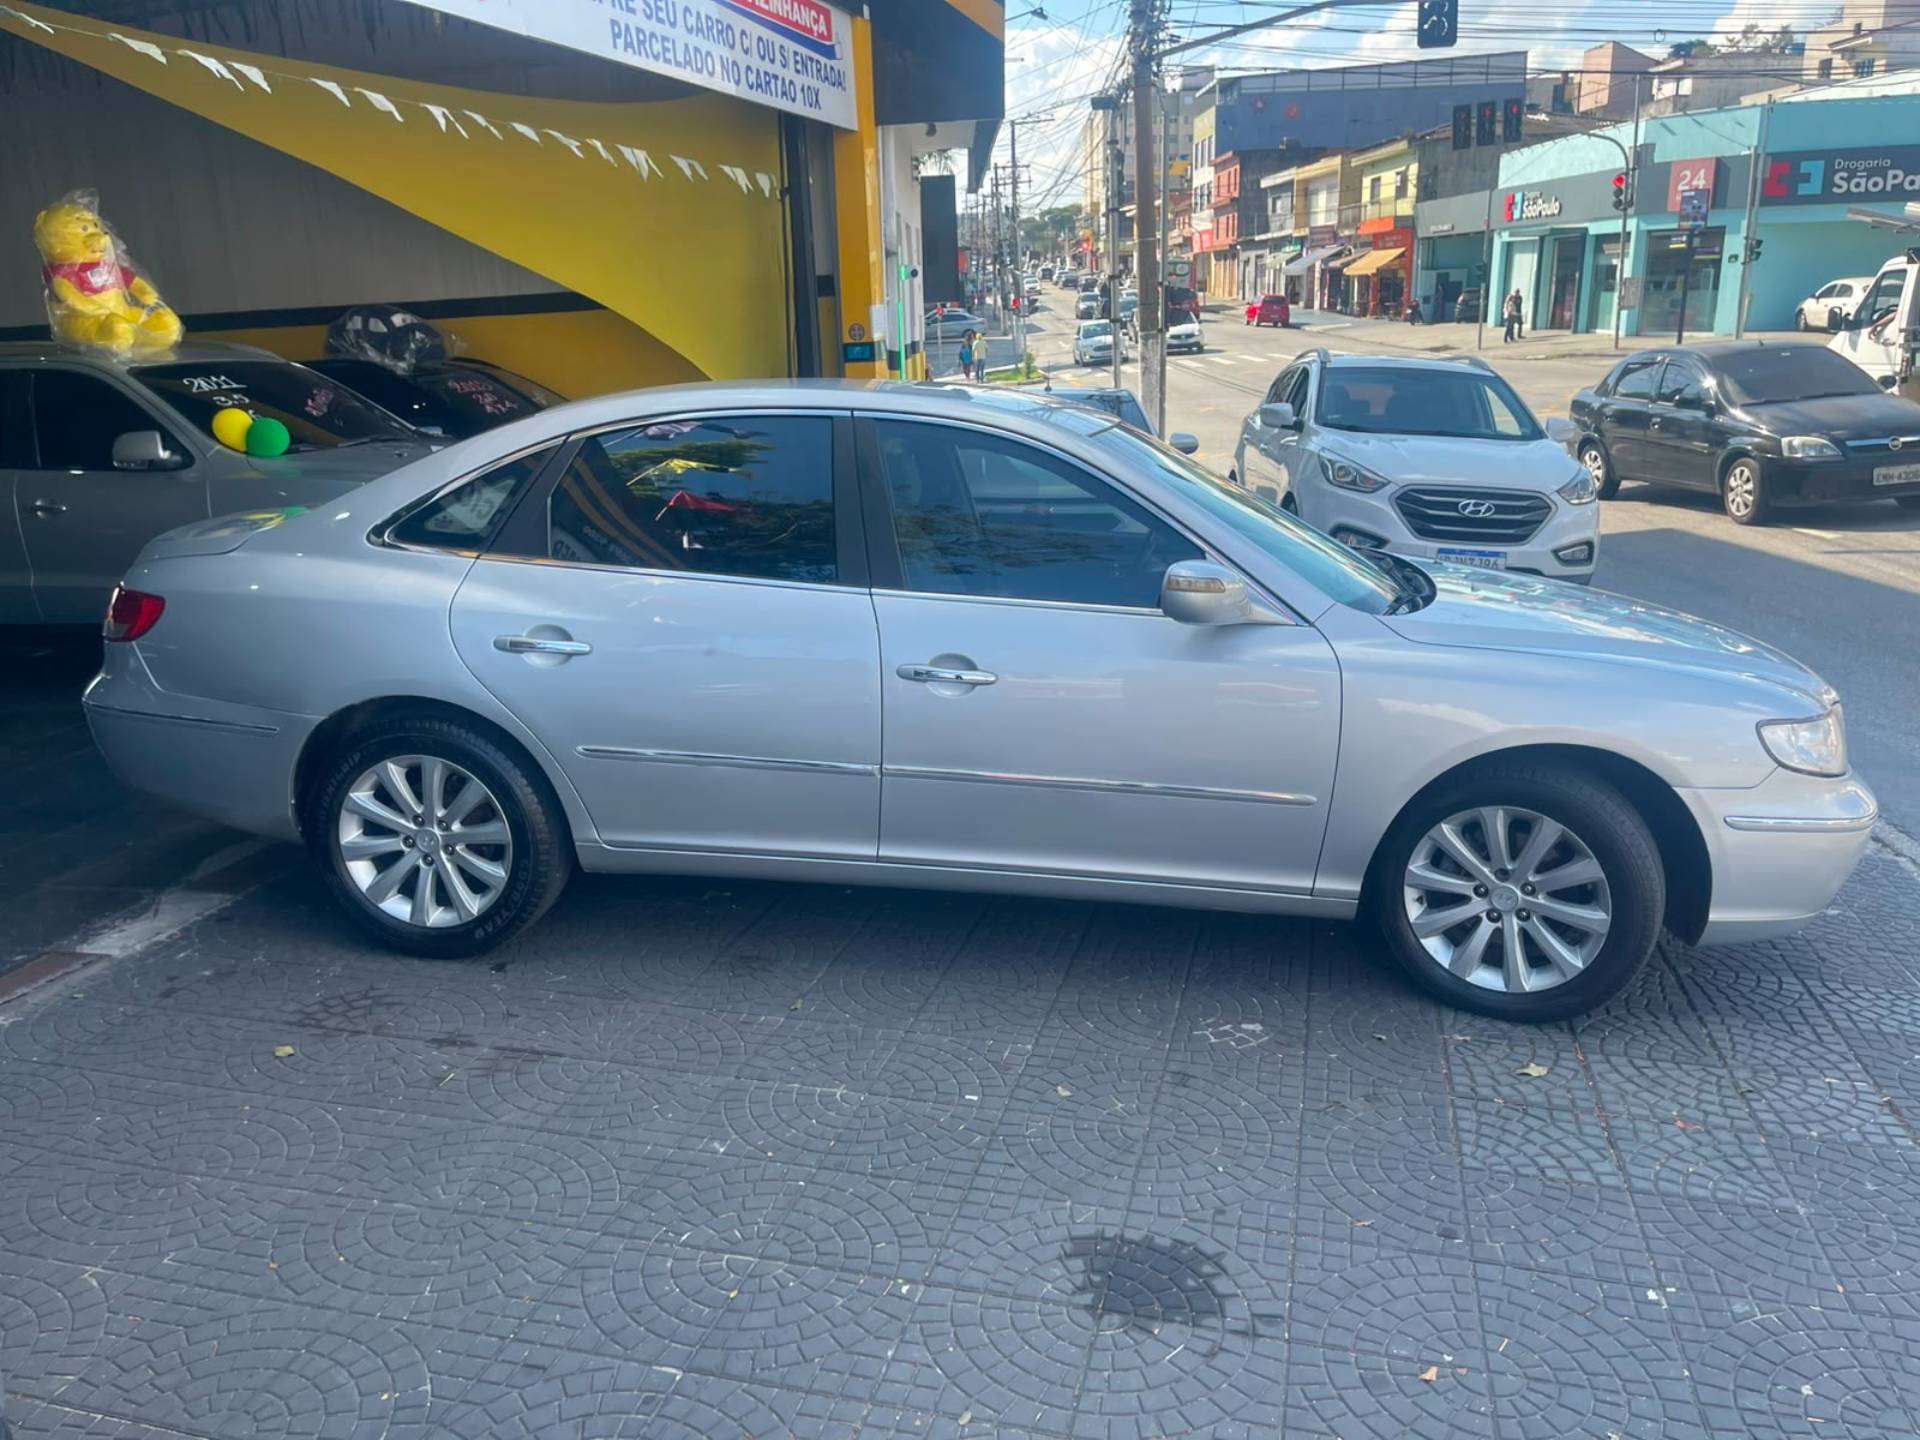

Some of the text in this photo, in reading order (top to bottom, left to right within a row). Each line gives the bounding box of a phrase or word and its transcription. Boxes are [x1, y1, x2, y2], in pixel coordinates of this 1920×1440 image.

[642, 0, 678, 29] SEU
[683, 5, 736, 50] CARRO
[740, 28, 753, 58] C/
[757, 35, 776, 65] OU
[779, 44, 790, 71] S/
[792, 49, 847, 93] ENTRADA!
[610, 18, 822, 110] PARCELADO NO CARTAO 10X
[1834, 157, 1891, 171] Drogaria
[1677, 169, 1706, 191] 24
[183, 375, 248, 393] 2011
